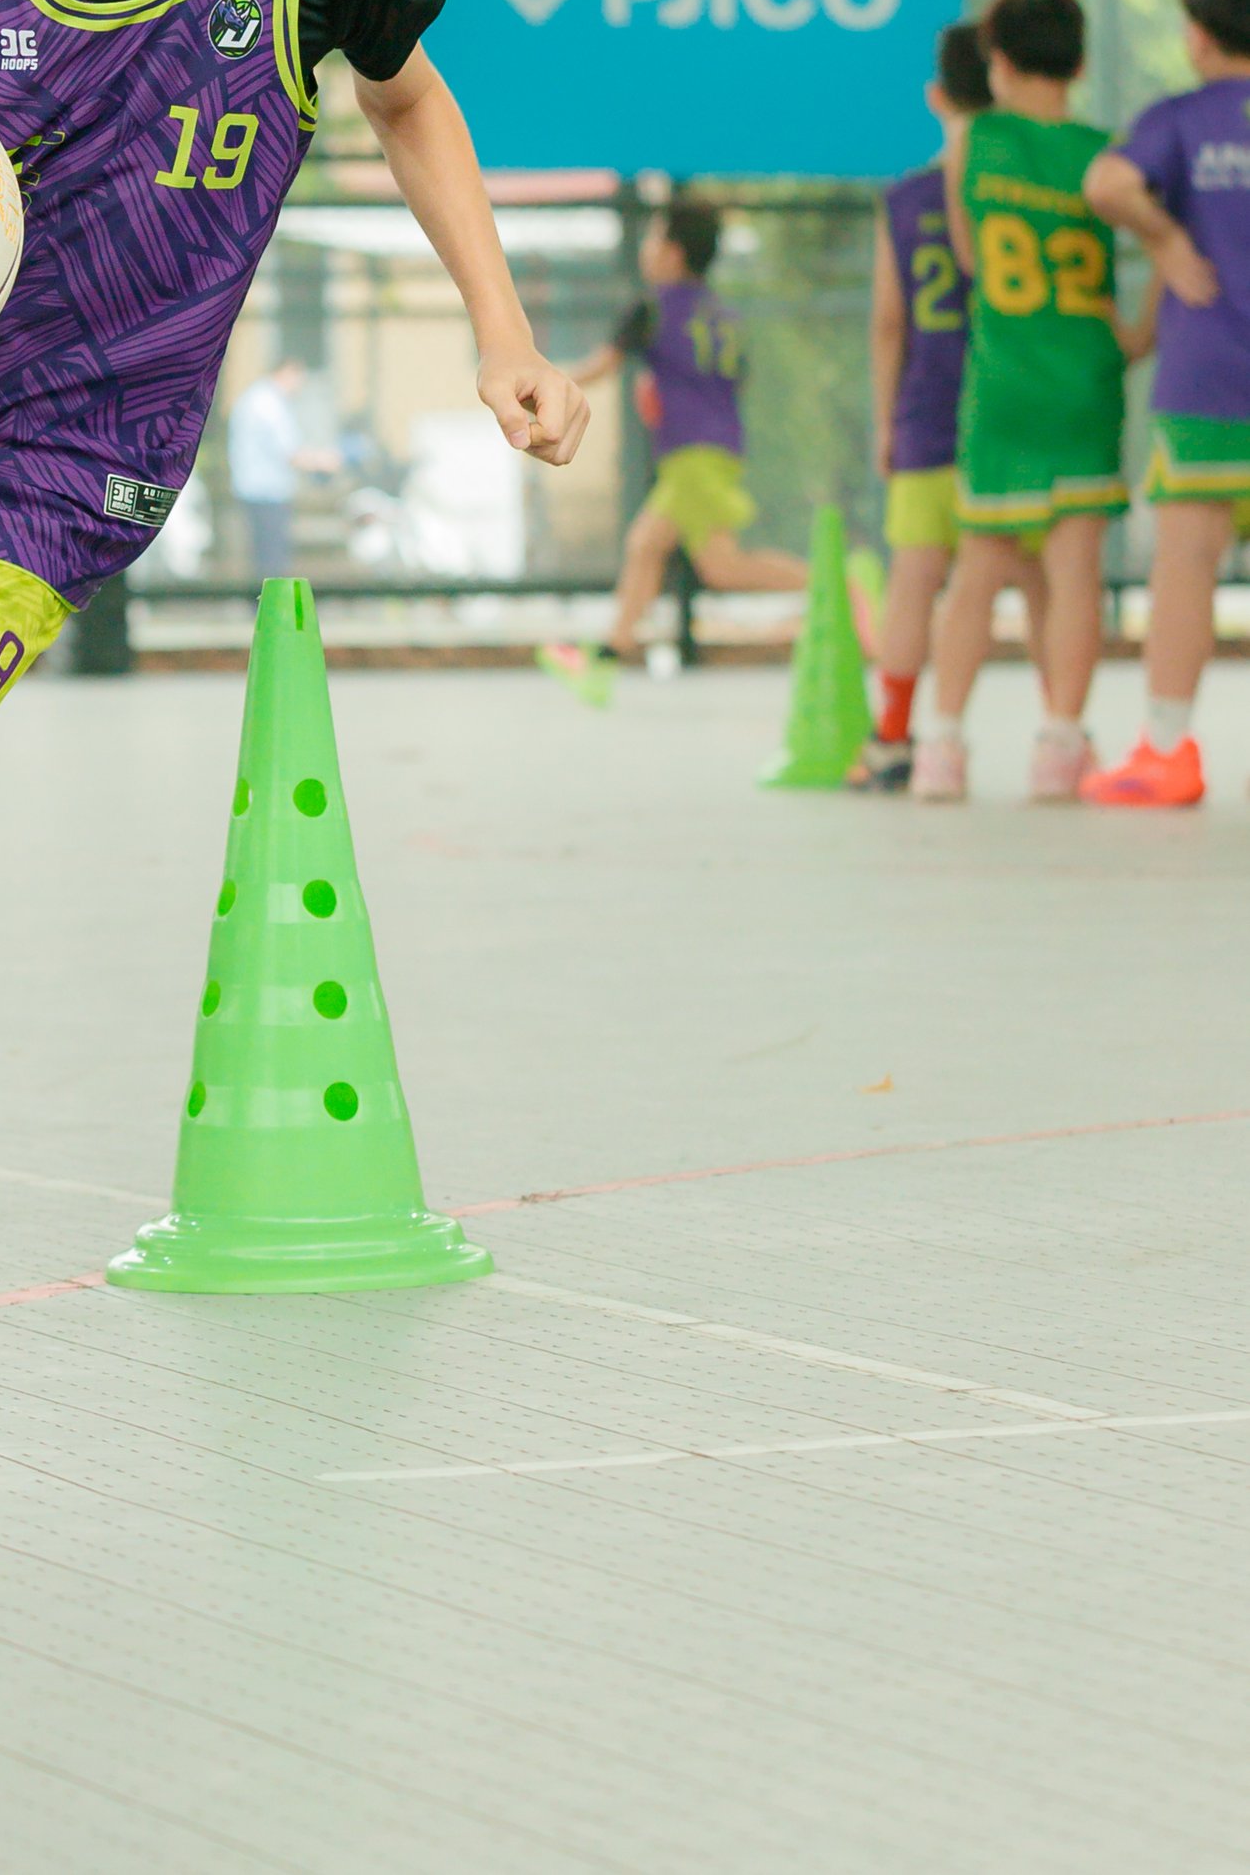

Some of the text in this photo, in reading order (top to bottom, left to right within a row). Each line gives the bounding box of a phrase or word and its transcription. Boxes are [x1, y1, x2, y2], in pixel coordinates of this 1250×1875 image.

[0, 58, 39, 71] HOOPS
[154, 105, 259, 189] 19
[980, 212, 1110, 317] 82
